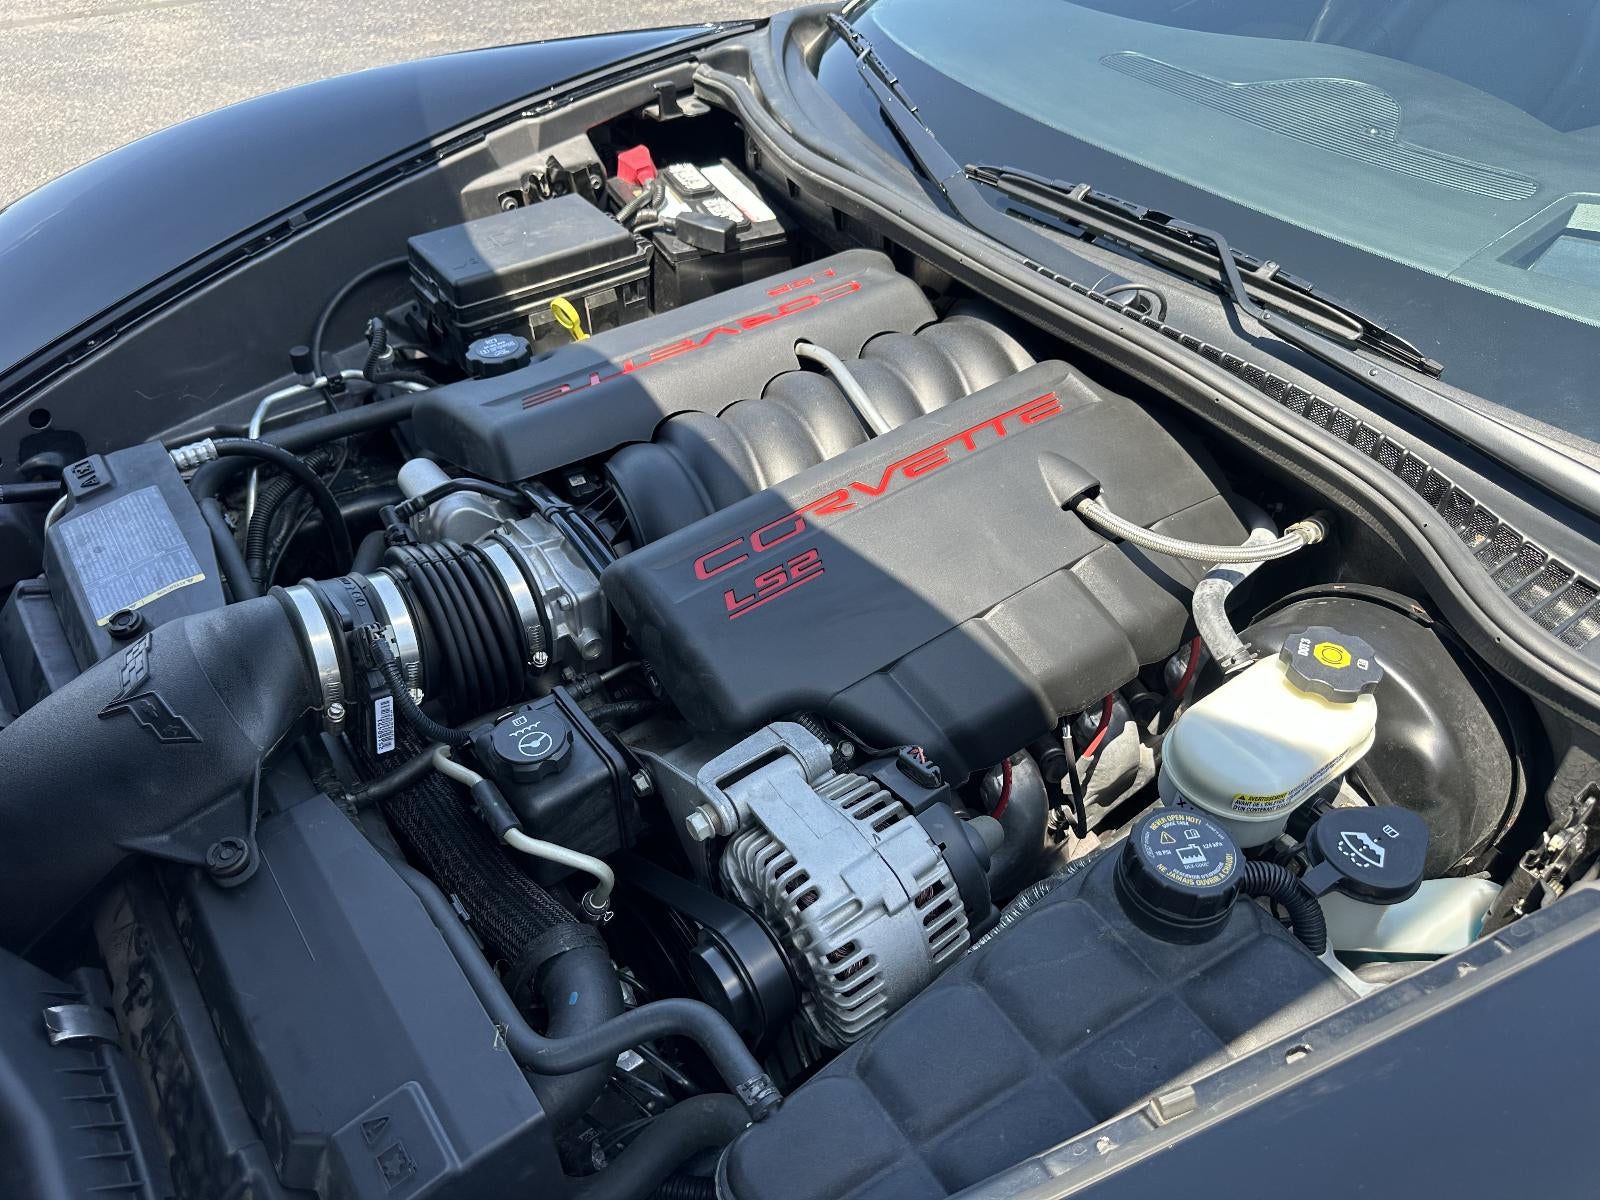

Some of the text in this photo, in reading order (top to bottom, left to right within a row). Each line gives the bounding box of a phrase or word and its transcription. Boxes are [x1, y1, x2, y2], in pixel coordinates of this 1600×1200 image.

[522, 279, 862, 410] CORVETTE
[693, 391, 1063, 581] CORVETTE
[723, 547, 823, 612] LS2
[1298, 642, 1310, 656] DOT
[1185, 815, 1201, 825] HOT!
[1157, 863, 1167, 873] NE
[1167, 869, 1195, 885] JAMAIS
[1195, 875, 1221, 886] OUVRIR
